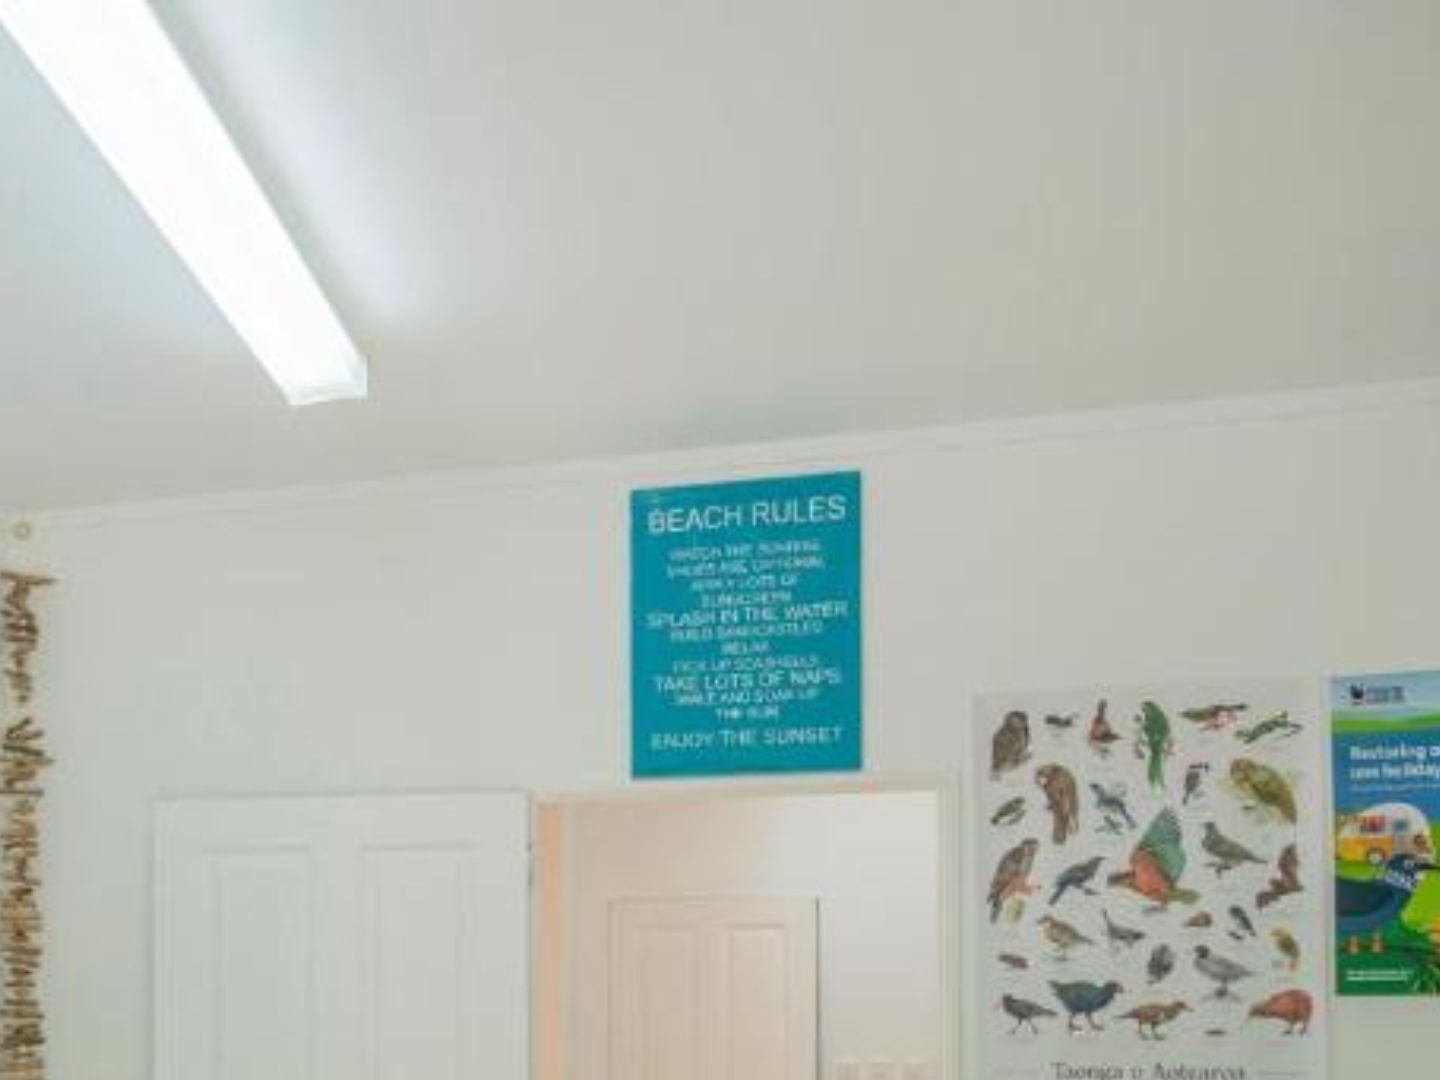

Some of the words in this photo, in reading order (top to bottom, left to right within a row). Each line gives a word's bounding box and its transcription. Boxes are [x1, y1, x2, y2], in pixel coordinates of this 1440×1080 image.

[648, 505, 742, 535] BEACH
[752, 495, 846, 526] RULES
[646, 608, 716, 629] SPLASH
[720, 607, 739, 623] IN
[744, 605, 778, 622] THE
[784, 600, 849, 619] WATER
[655, 675, 699, 693] TAKE
[703, 672, 755, 690] LOTS
[760, 670, 786, 687] OF
[789, 667, 843, 685] NAPS
[650, 732, 716, 750] ENJOY
[718, 729, 758, 748] THE
[763, 726, 844, 745] SUNSET
